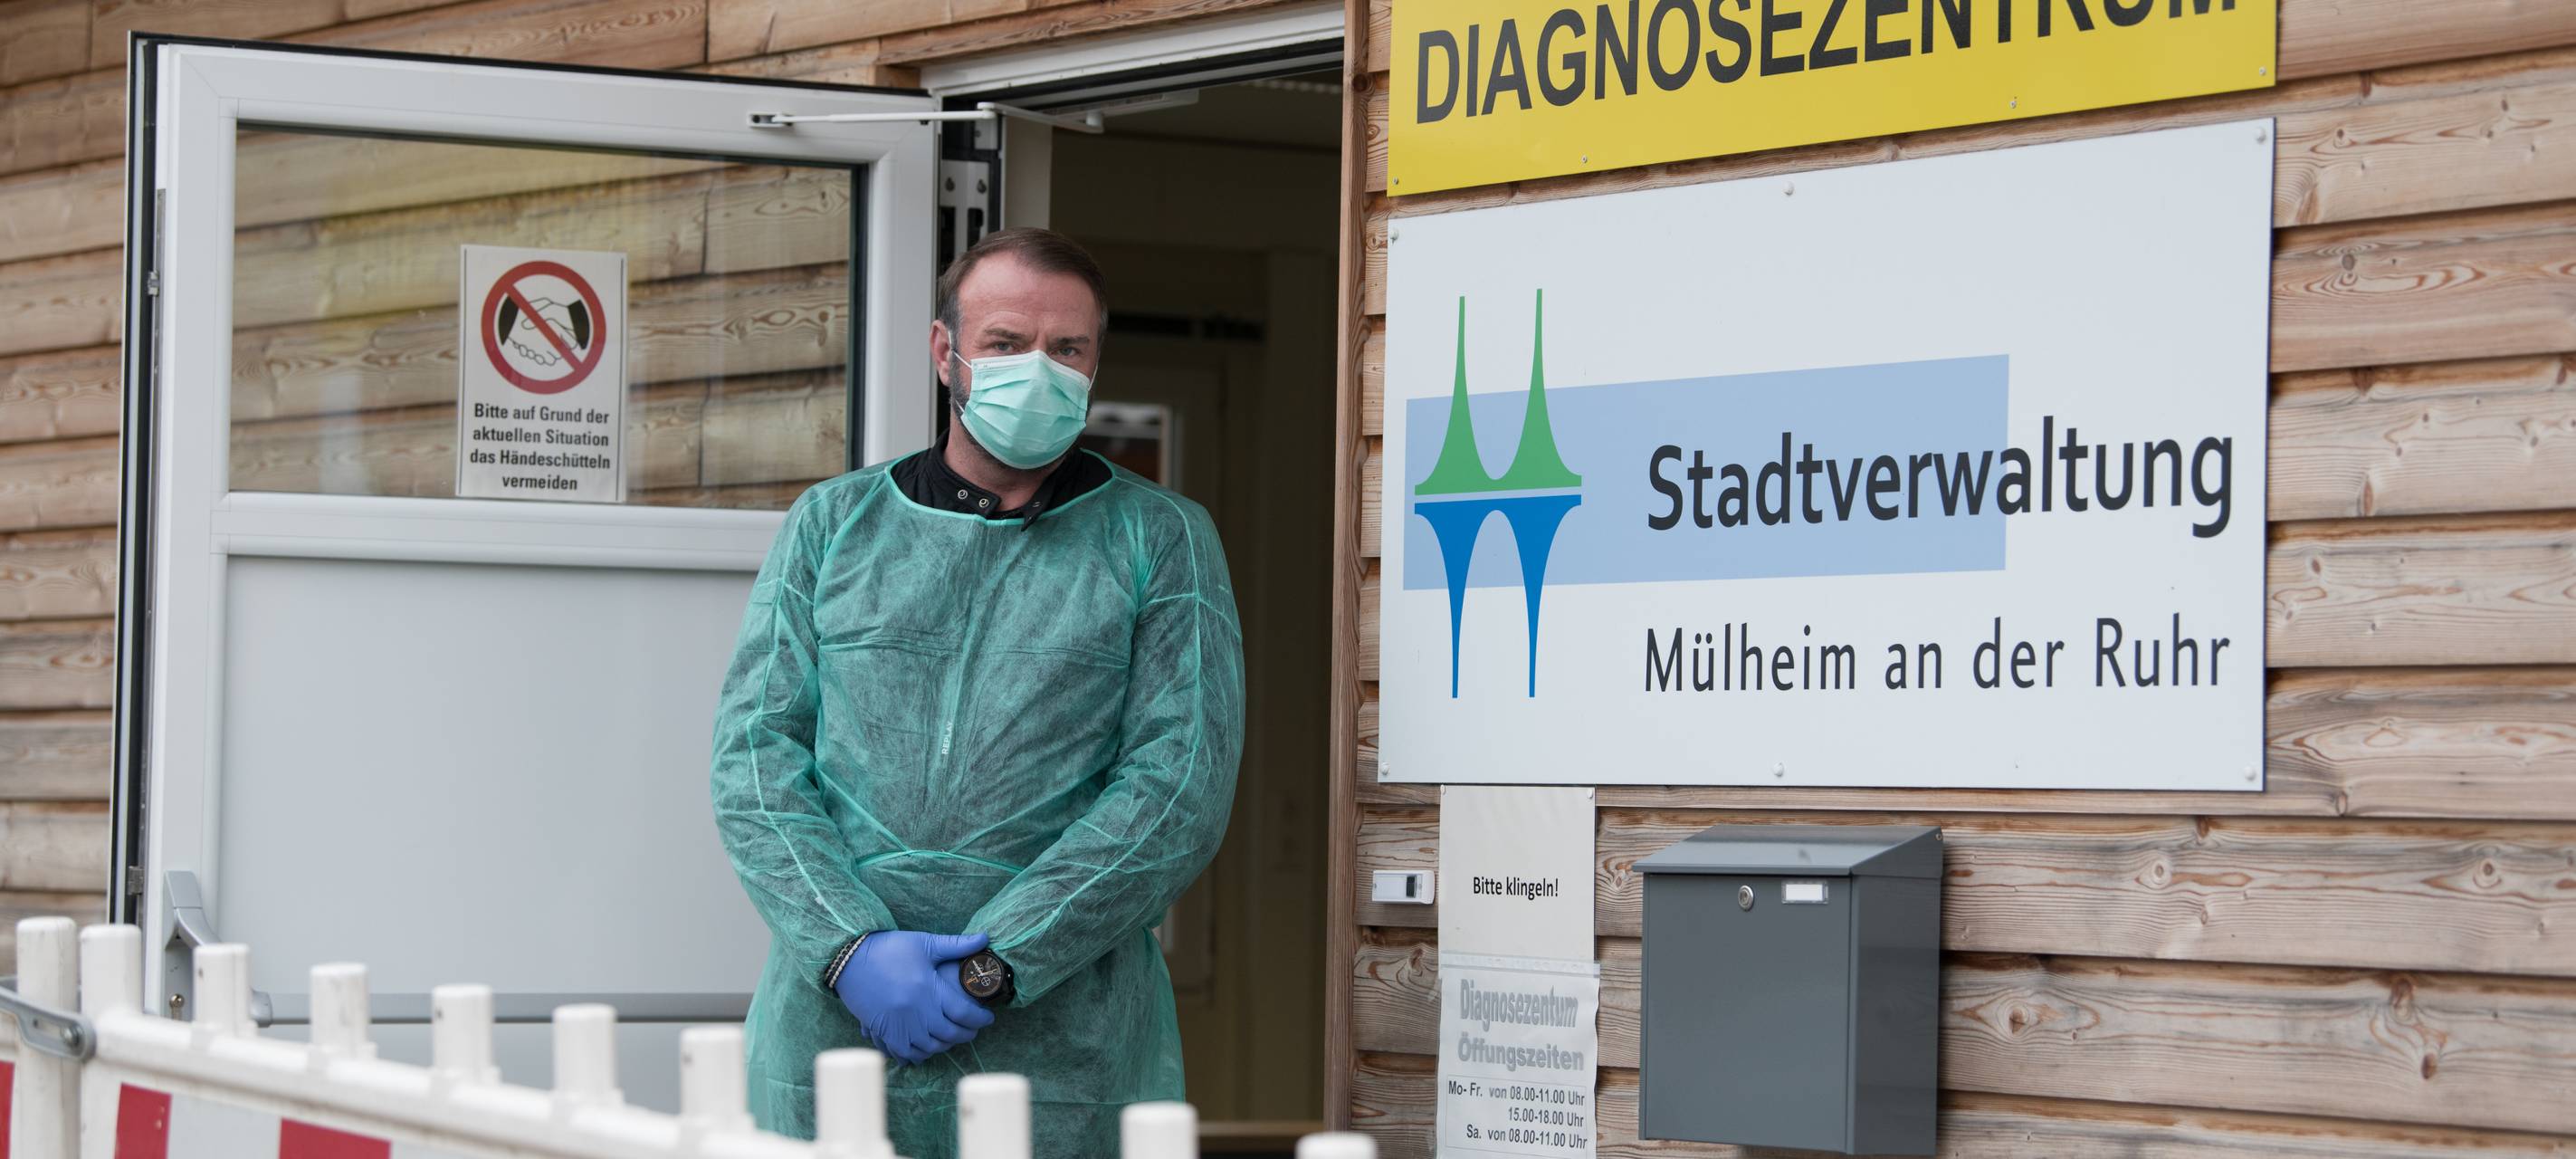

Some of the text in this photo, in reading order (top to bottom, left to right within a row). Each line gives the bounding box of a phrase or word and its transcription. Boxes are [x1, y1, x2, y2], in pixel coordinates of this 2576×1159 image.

[1417, 0, 2236, 124] DIAGNOSEZEN
[474, 402, 610, 424] Bitte auf Grund der
[473, 426, 609, 446] aktuellen Situation
[470, 448, 611, 470] das Händeschütteln
[502, 474, 578, 491] vermeiden
[1647, 416, 2233, 539] Stadtverwaltung
[1645, 612, 2231, 692] Mülheim an der Ruhr
[941, 720, 953, 755] REPLAY
[1473, 876, 1559, 901] Bitte klingeln!
[1448, 1080, 1585, 1106] Mo- Fr. von 08.00-11.00 Uhr
[1508, 1106, 1584, 1127] 15.00-18.00 Uhr
[1466, 1124, 1588, 1150] Sa. von 08.00-11.00 Uhr
